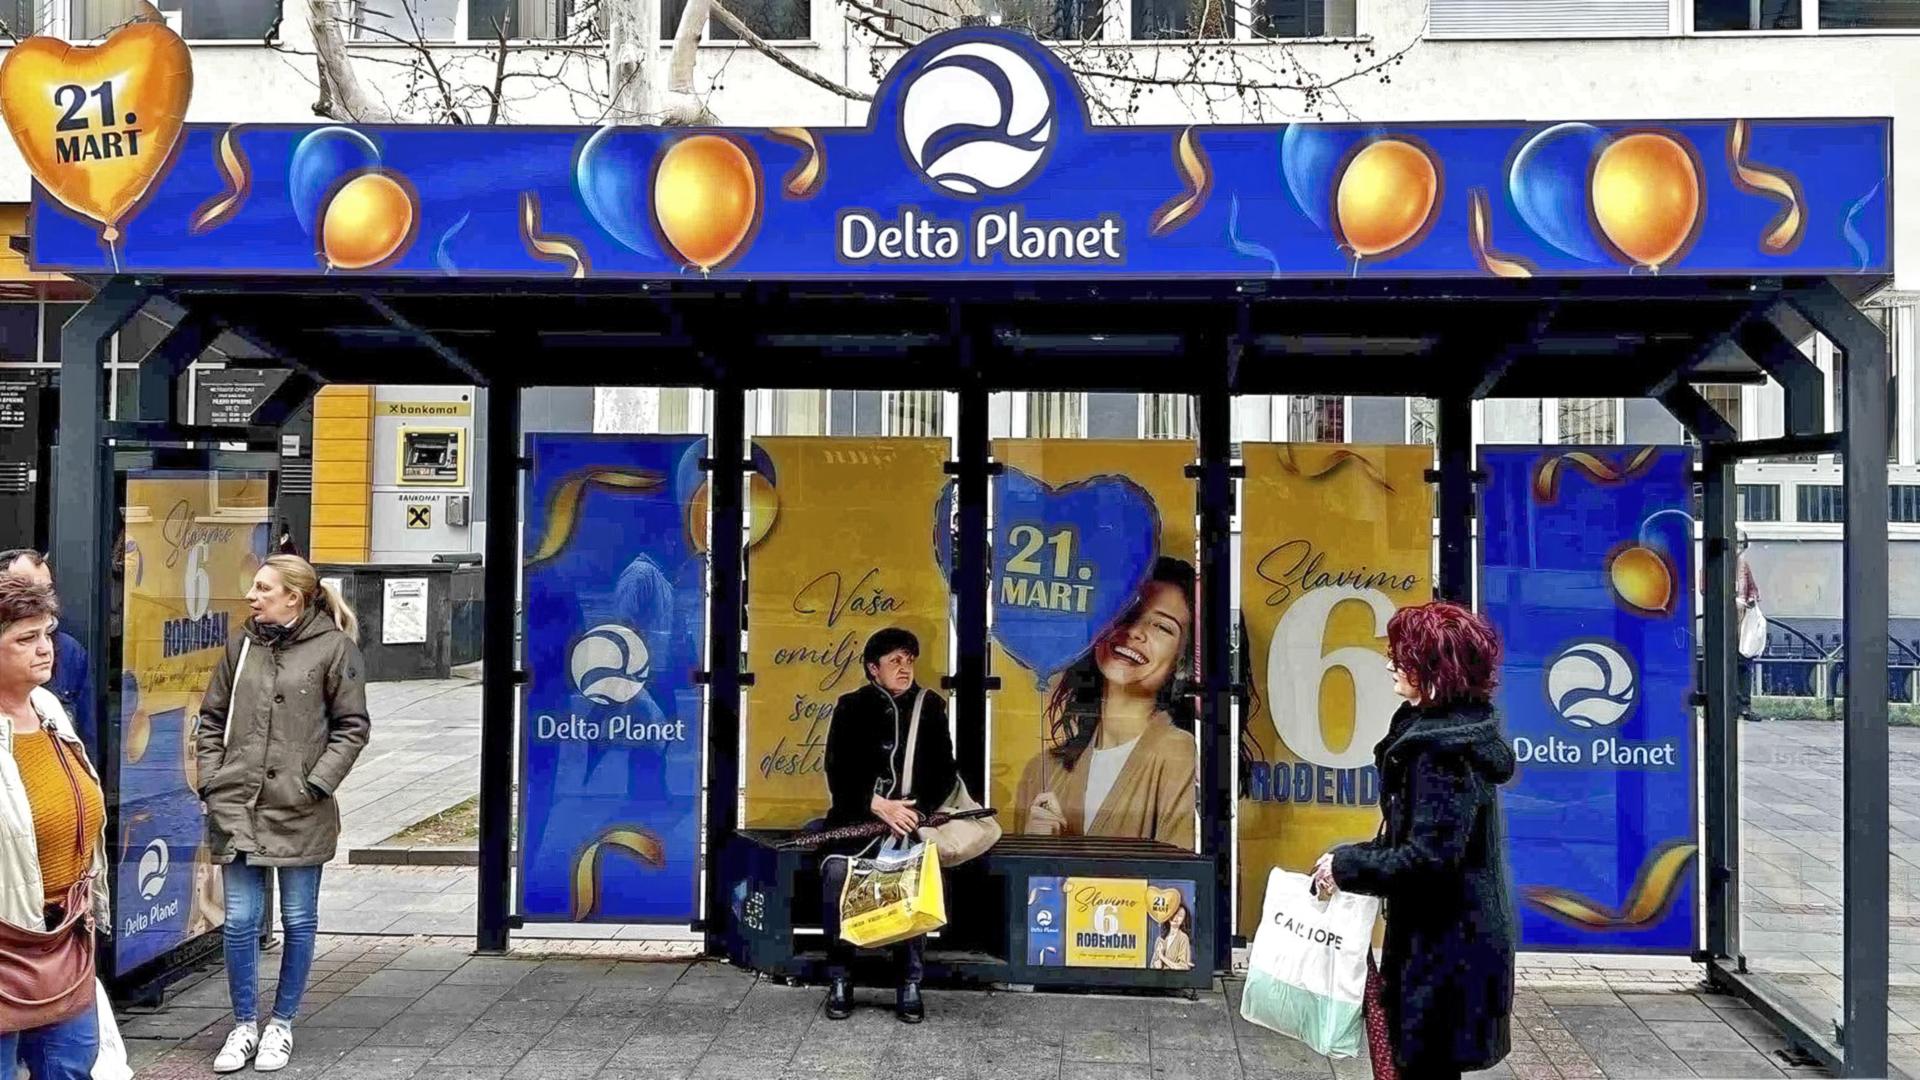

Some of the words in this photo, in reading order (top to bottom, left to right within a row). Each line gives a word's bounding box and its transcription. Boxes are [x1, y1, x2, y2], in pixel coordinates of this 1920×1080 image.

[54, 80, 137, 132] 21.
[55, 129, 143, 164] MART
[842, 211, 959, 258] Delta
[977, 211, 1120, 258] Planet
[400, 403, 457, 414] bankomat
[398, 494, 441, 502] BANKOMAT
[1005, 525, 1091, 580] 21.
[1256, 539, 1421, 606] Slavimo
[186, 543, 210, 622] 6
[793, 567, 905, 627] Vaša
[1000, 576, 1094, 613] MART
[774, 630, 864, 692] omilj
[1267, 584, 1402, 769] 6
[537, 714, 599, 740] Delta
[608, 715, 685, 741] Planet
[788, 694, 833, 744] šop
[760, 735, 826, 779] desti
[1513, 736, 1581, 763] Delta
[1592, 738, 1675, 765] Planet
[1250, 761, 1380, 806] ROĐEND
[125, 914, 148, 937] Delta
[150, 899, 178, 925] Planet
[1074, 886, 1137, 913] Slavimo
[1094, 905, 1119, 935] 6
